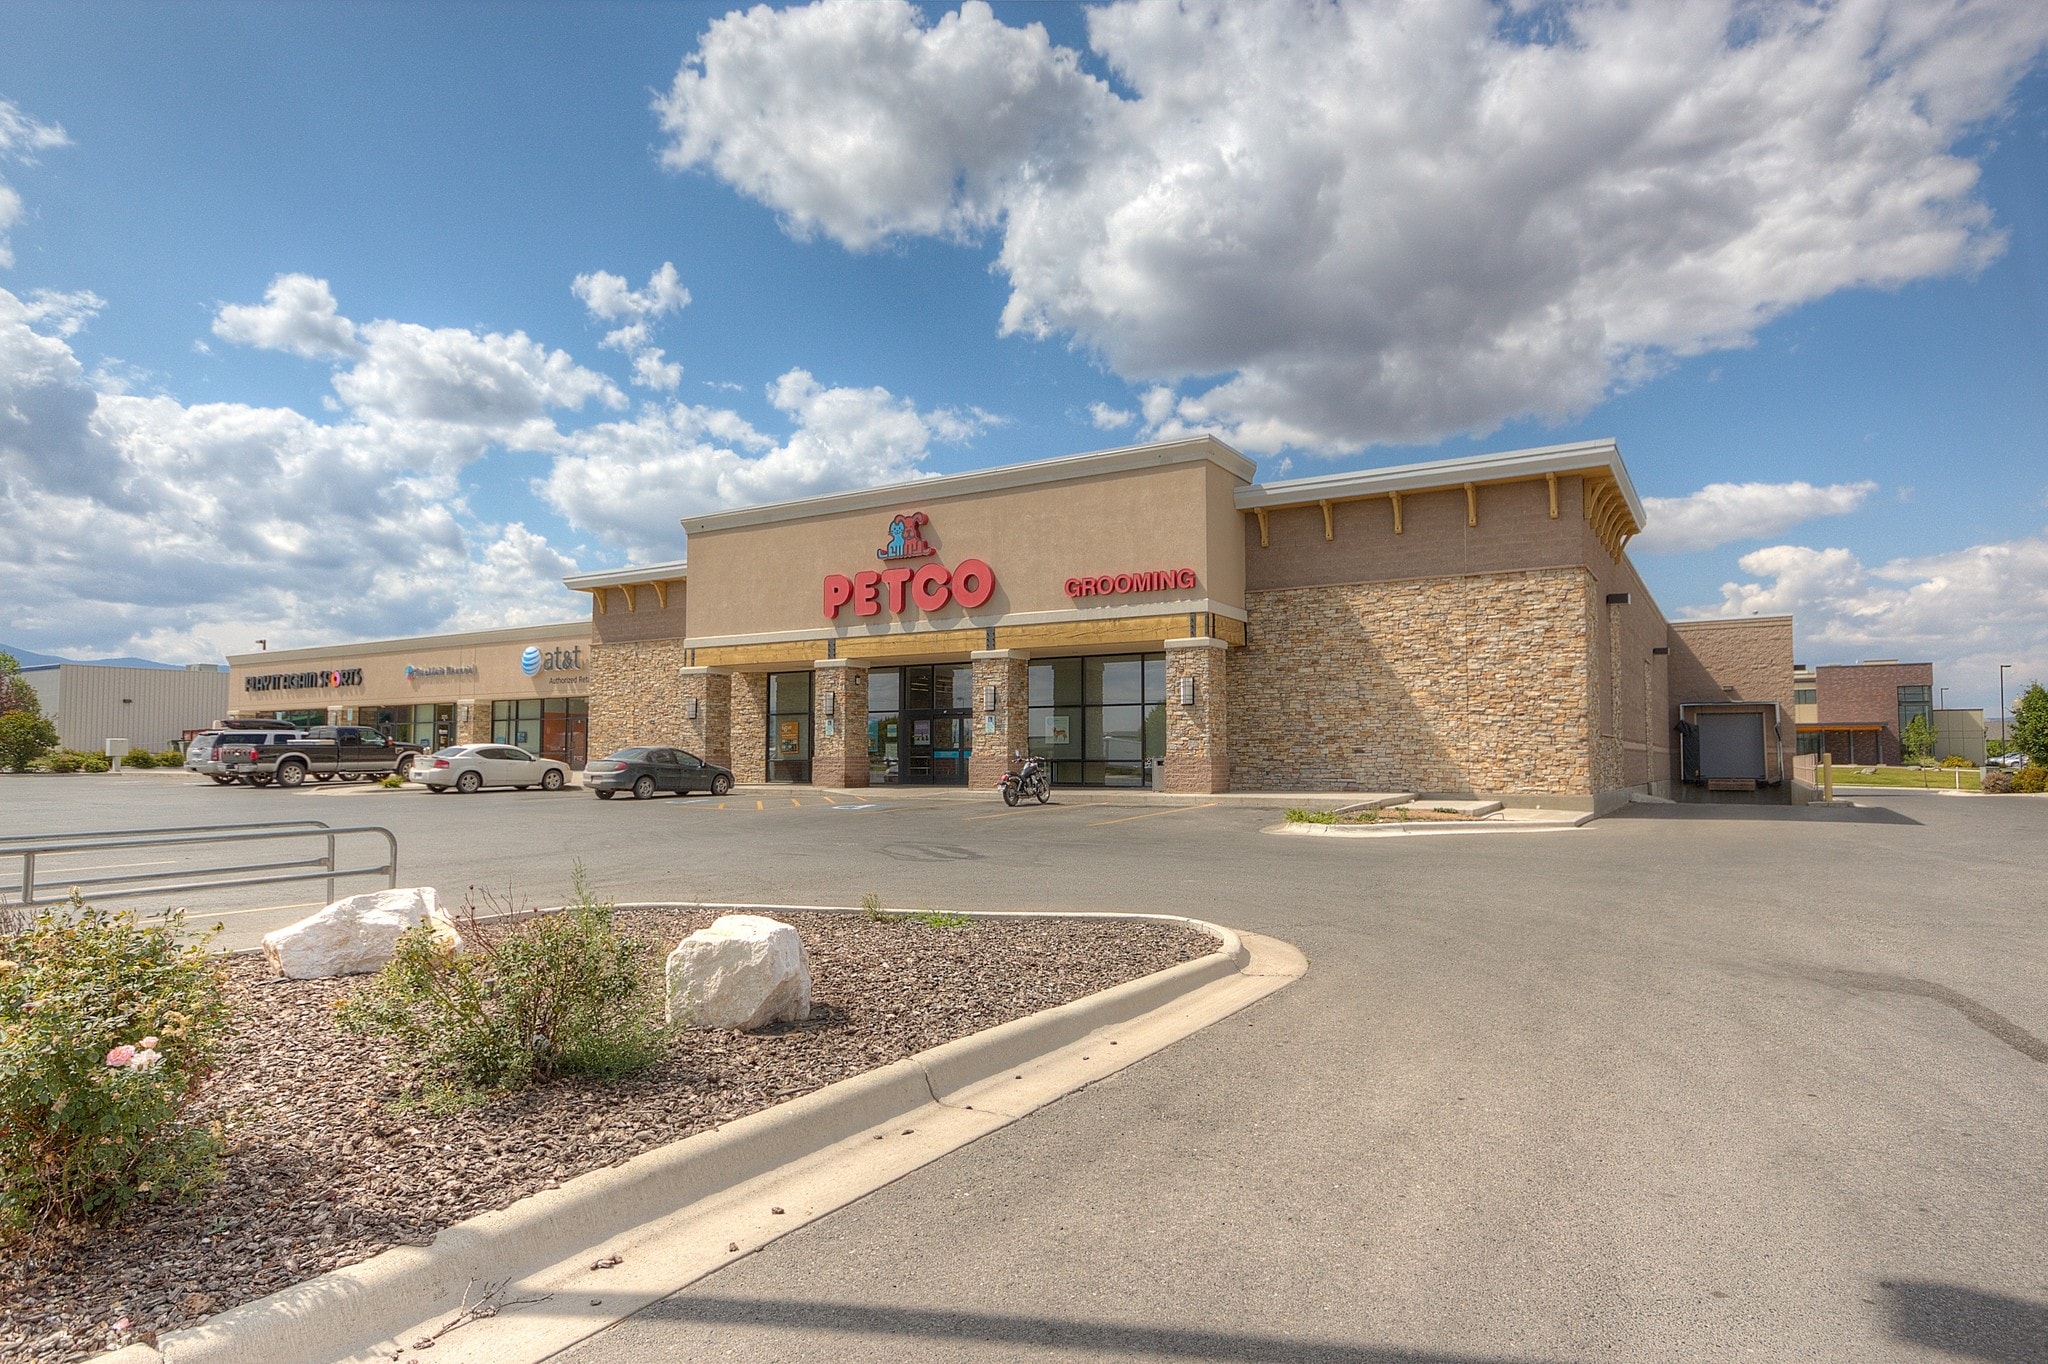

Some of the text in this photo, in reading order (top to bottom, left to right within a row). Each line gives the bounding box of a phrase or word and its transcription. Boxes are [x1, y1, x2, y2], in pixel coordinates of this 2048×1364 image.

[823, 558, 996, 619] PETCO
[1064, 568, 1197, 598] GROOMING
[543, 645, 581, 671] at&t
[245, 668, 363, 692] PLAY IT AGAIN SPORTS
[549, 676, 578, 685] Authorized
